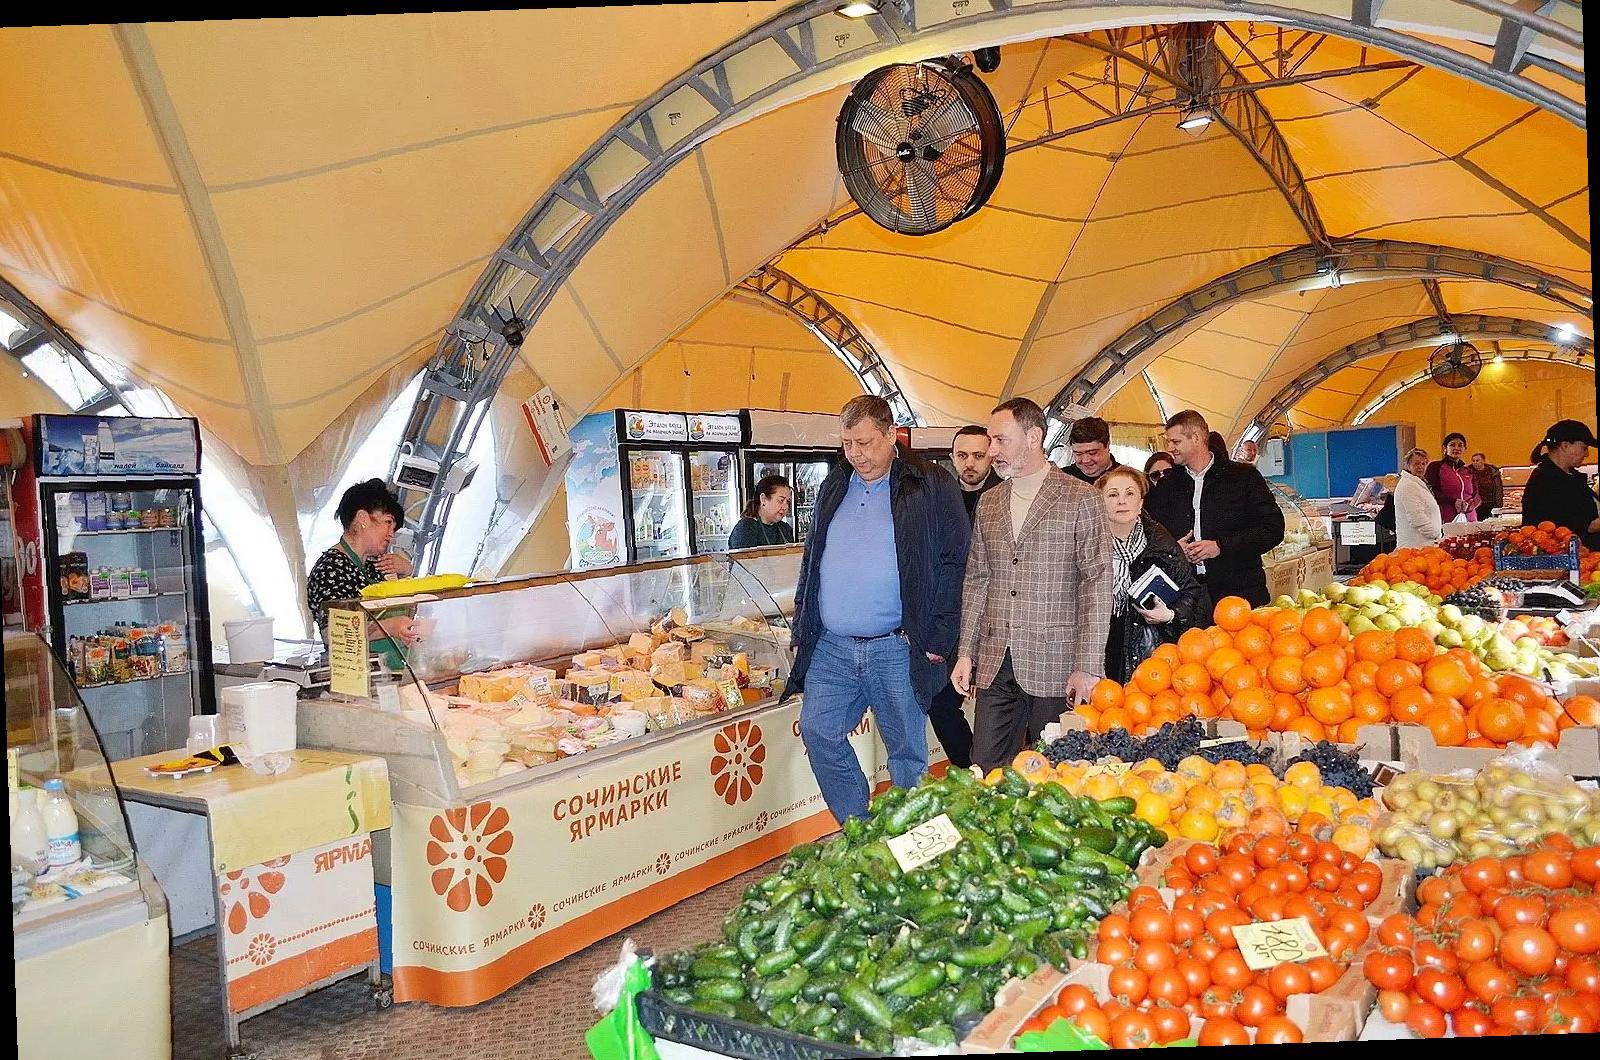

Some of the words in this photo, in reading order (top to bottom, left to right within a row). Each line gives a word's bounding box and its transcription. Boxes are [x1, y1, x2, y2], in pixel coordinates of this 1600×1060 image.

[553, 761, 682, 821] СОЧИНСКИЕ
[770, 798, 806, 820] СОЧИНСКИЕ
[570, 789, 669, 843] ЯРМАРКИ
[674, 837, 719, 862] СОЧИНСКИЕ
[722, 821, 754, 842] ЯРМАРКИ
[553, 882, 607, 913] СОЧИНСКИЕ
[612, 864, 653, 888] ЯРМАРКИ
[413, 940, 476, 956] СОЧИНСКИЕ
[483, 919, 526, 948] ЯРМАРКИ
[1260, 924, 1303, 961] 180
